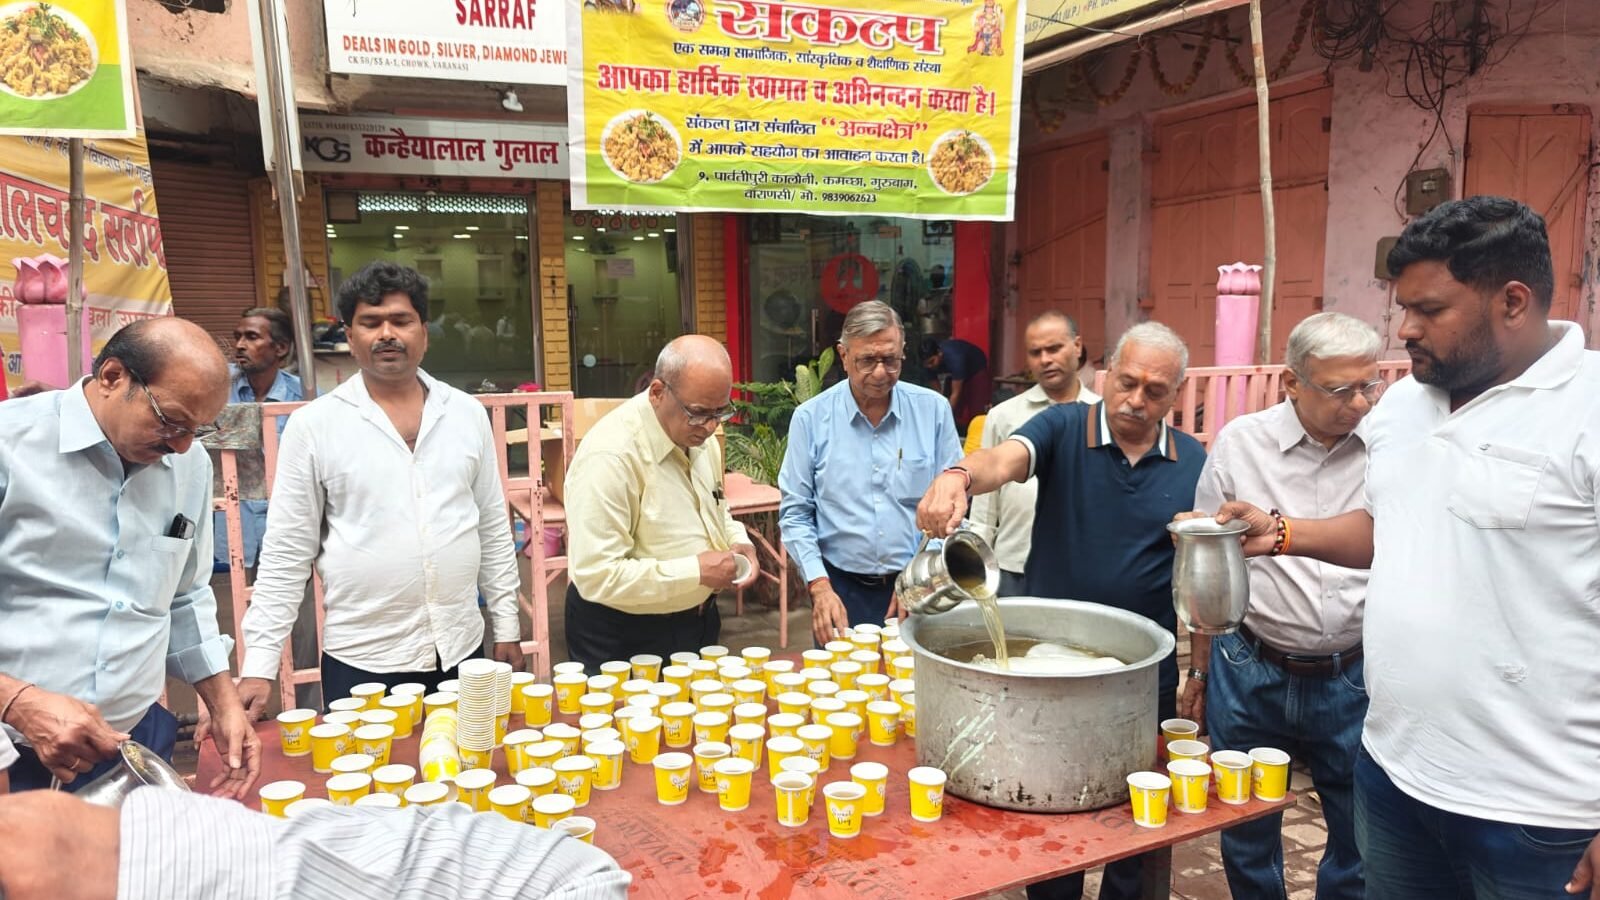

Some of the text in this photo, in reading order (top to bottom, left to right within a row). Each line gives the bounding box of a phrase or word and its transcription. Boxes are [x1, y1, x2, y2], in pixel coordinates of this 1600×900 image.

[455, 0, 536, 30] SARRAF
[343, 35, 381, 53] DEALS
[384, 38, 396, 52] IN
[398, 39, 435, 59] GOLD,
[437, 42, 480, 62] SILVER,
[483, 45, 537, 63] DIAMOND
[673, 42, 941, 73] एक समग्र सामाजिक, सांस्कृतिक व शैक्षणिक संस्था
[433, 61, 469, 71] VARANASI
[598, 64, 671, 93] आपका
[677, 65, 741, 97] हार्दिक
[747, 74, 808, 101] स्वागत
[813, 80, 828, 103] व
[832, 76, 921, 109] अभिनन्दन
[928, 88, 970, 114] करता
[686, 113, 729, 130] संकल्प
[734, 119, 759, 133] द्वारा
[764, 118, 816, 135] संचालित
[362, 127, 559, 170] कन्हैयालाल गुलाल
[689, 139, 703, 154] में
[705, 141, 746, 155] आपके
[751, 144, 797, 158] सहयोग
[801, 148, 819, 159] का
[875, 151, 908, 163] करता
[714, 170, 768, 185] पार्वतीपुरी
[822, 193, 877, 203] 9839062623
[831, 807, 851, 817] Sweet
[837, 817, 851, 826] Day
